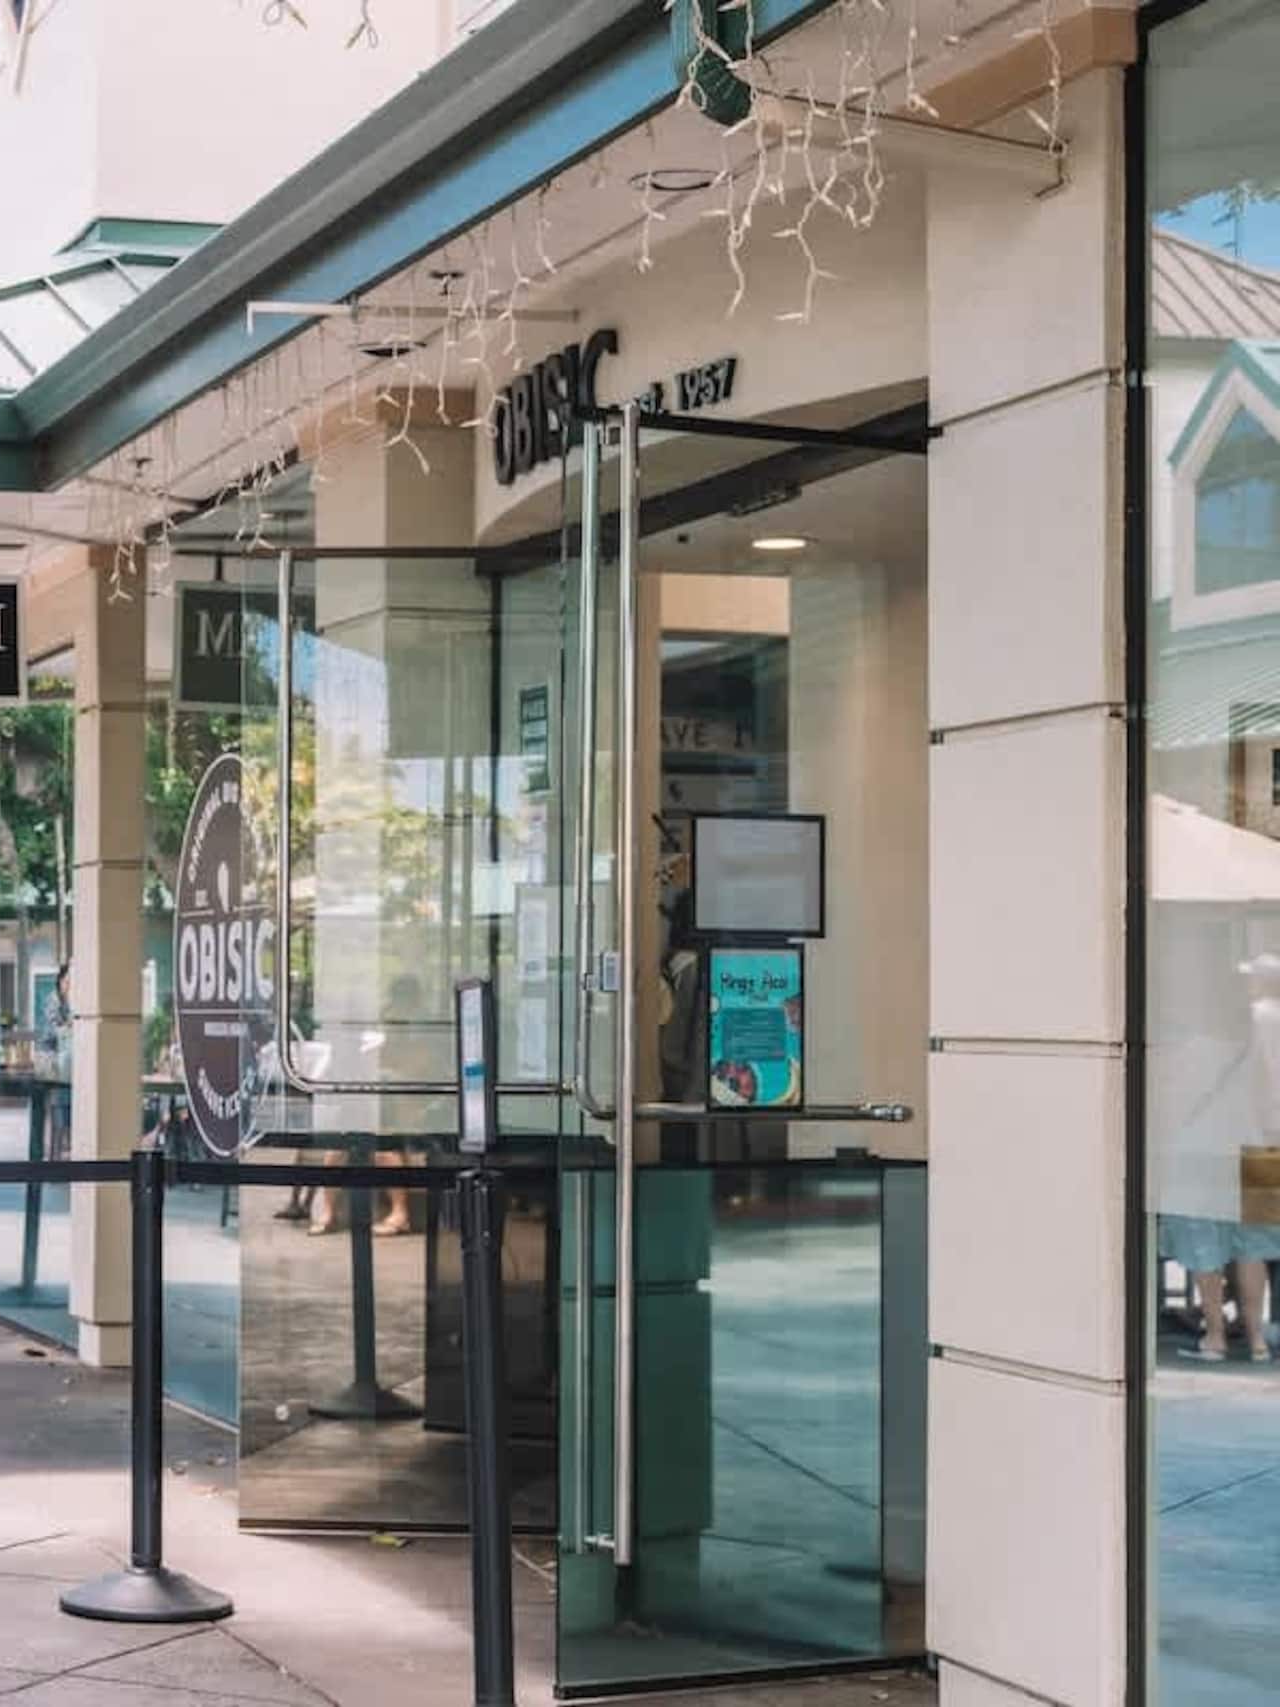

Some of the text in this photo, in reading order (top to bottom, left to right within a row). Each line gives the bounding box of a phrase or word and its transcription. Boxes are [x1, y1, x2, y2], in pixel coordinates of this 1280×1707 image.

[494, 328, 618, 484] OBISIC
[675, 358, 737, 411] 1957
[179, 919, 275, 1001] OBISIC
